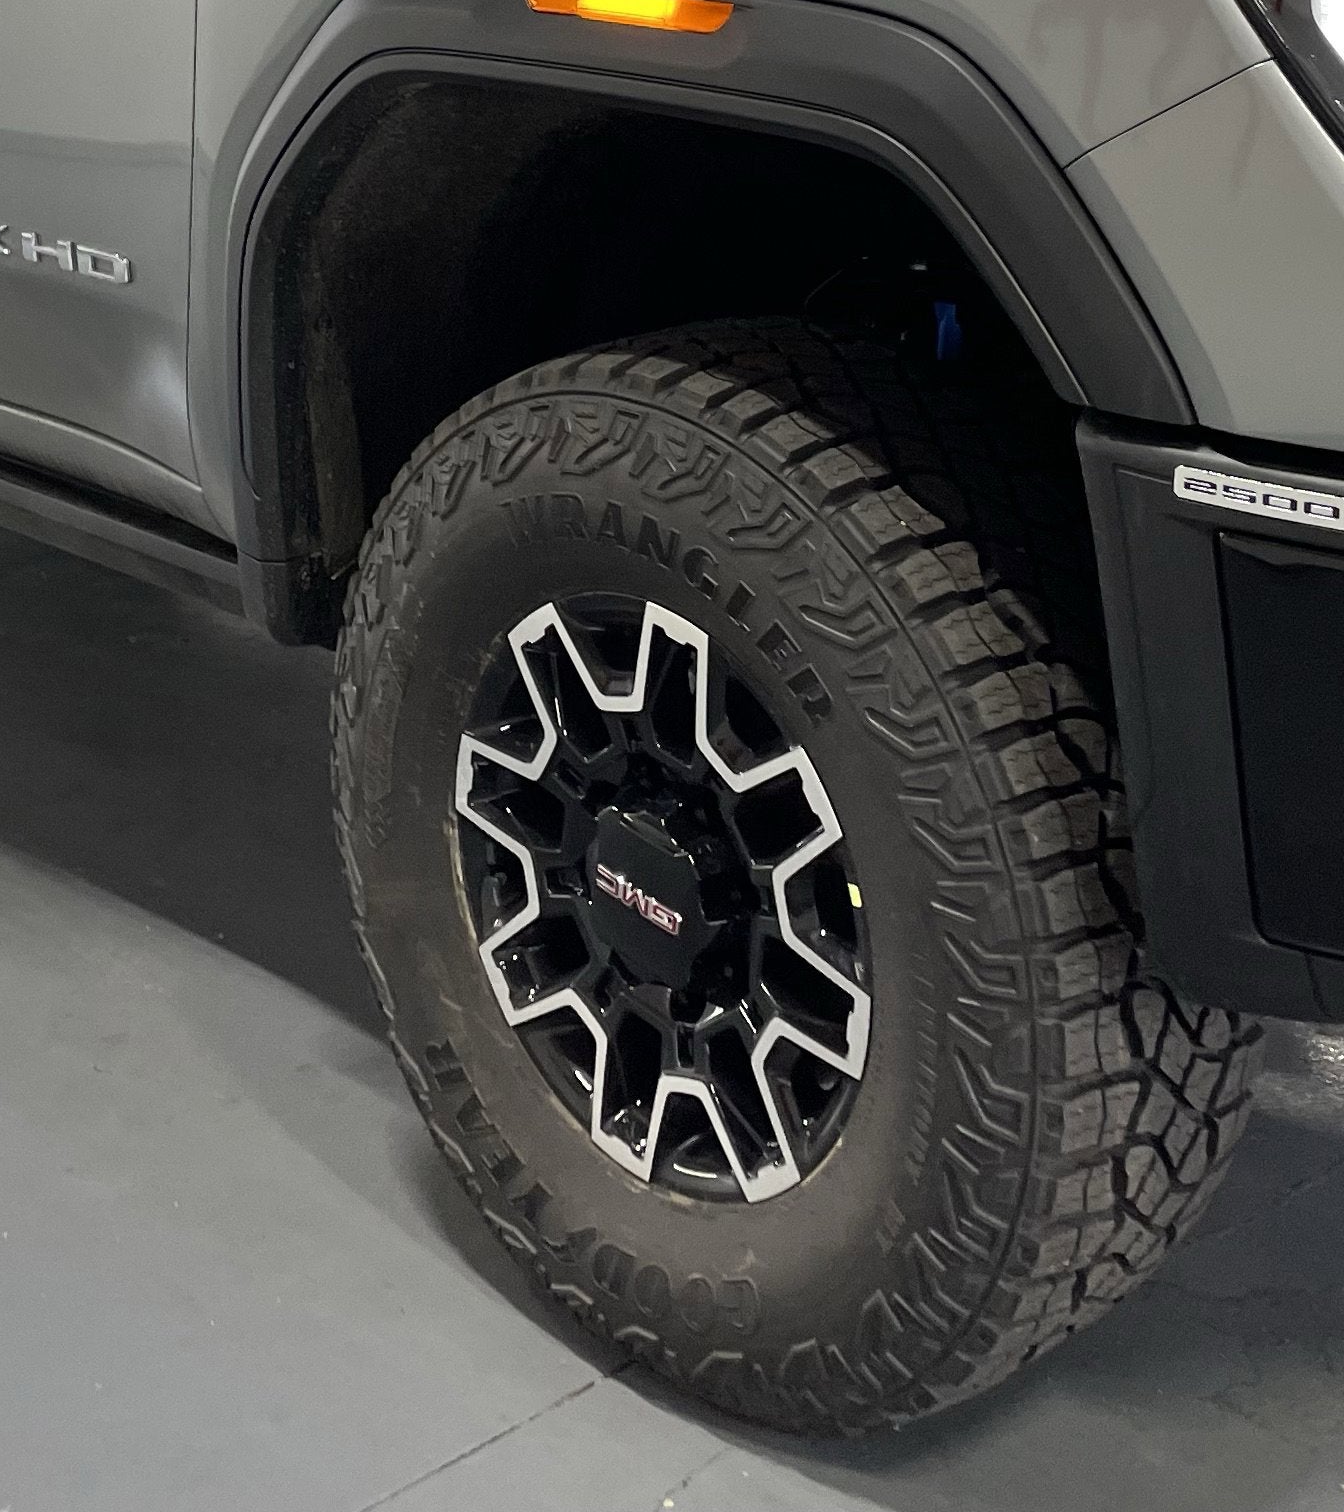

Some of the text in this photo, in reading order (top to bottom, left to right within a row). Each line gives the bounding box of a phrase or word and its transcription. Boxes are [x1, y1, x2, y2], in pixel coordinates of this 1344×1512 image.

[21, 231, 134, 284] HD
[1183, 476, 1340, 520] 2500
[499, 490, 835, 728] WRANGLER
[594, 862, 683, 936] GMC
